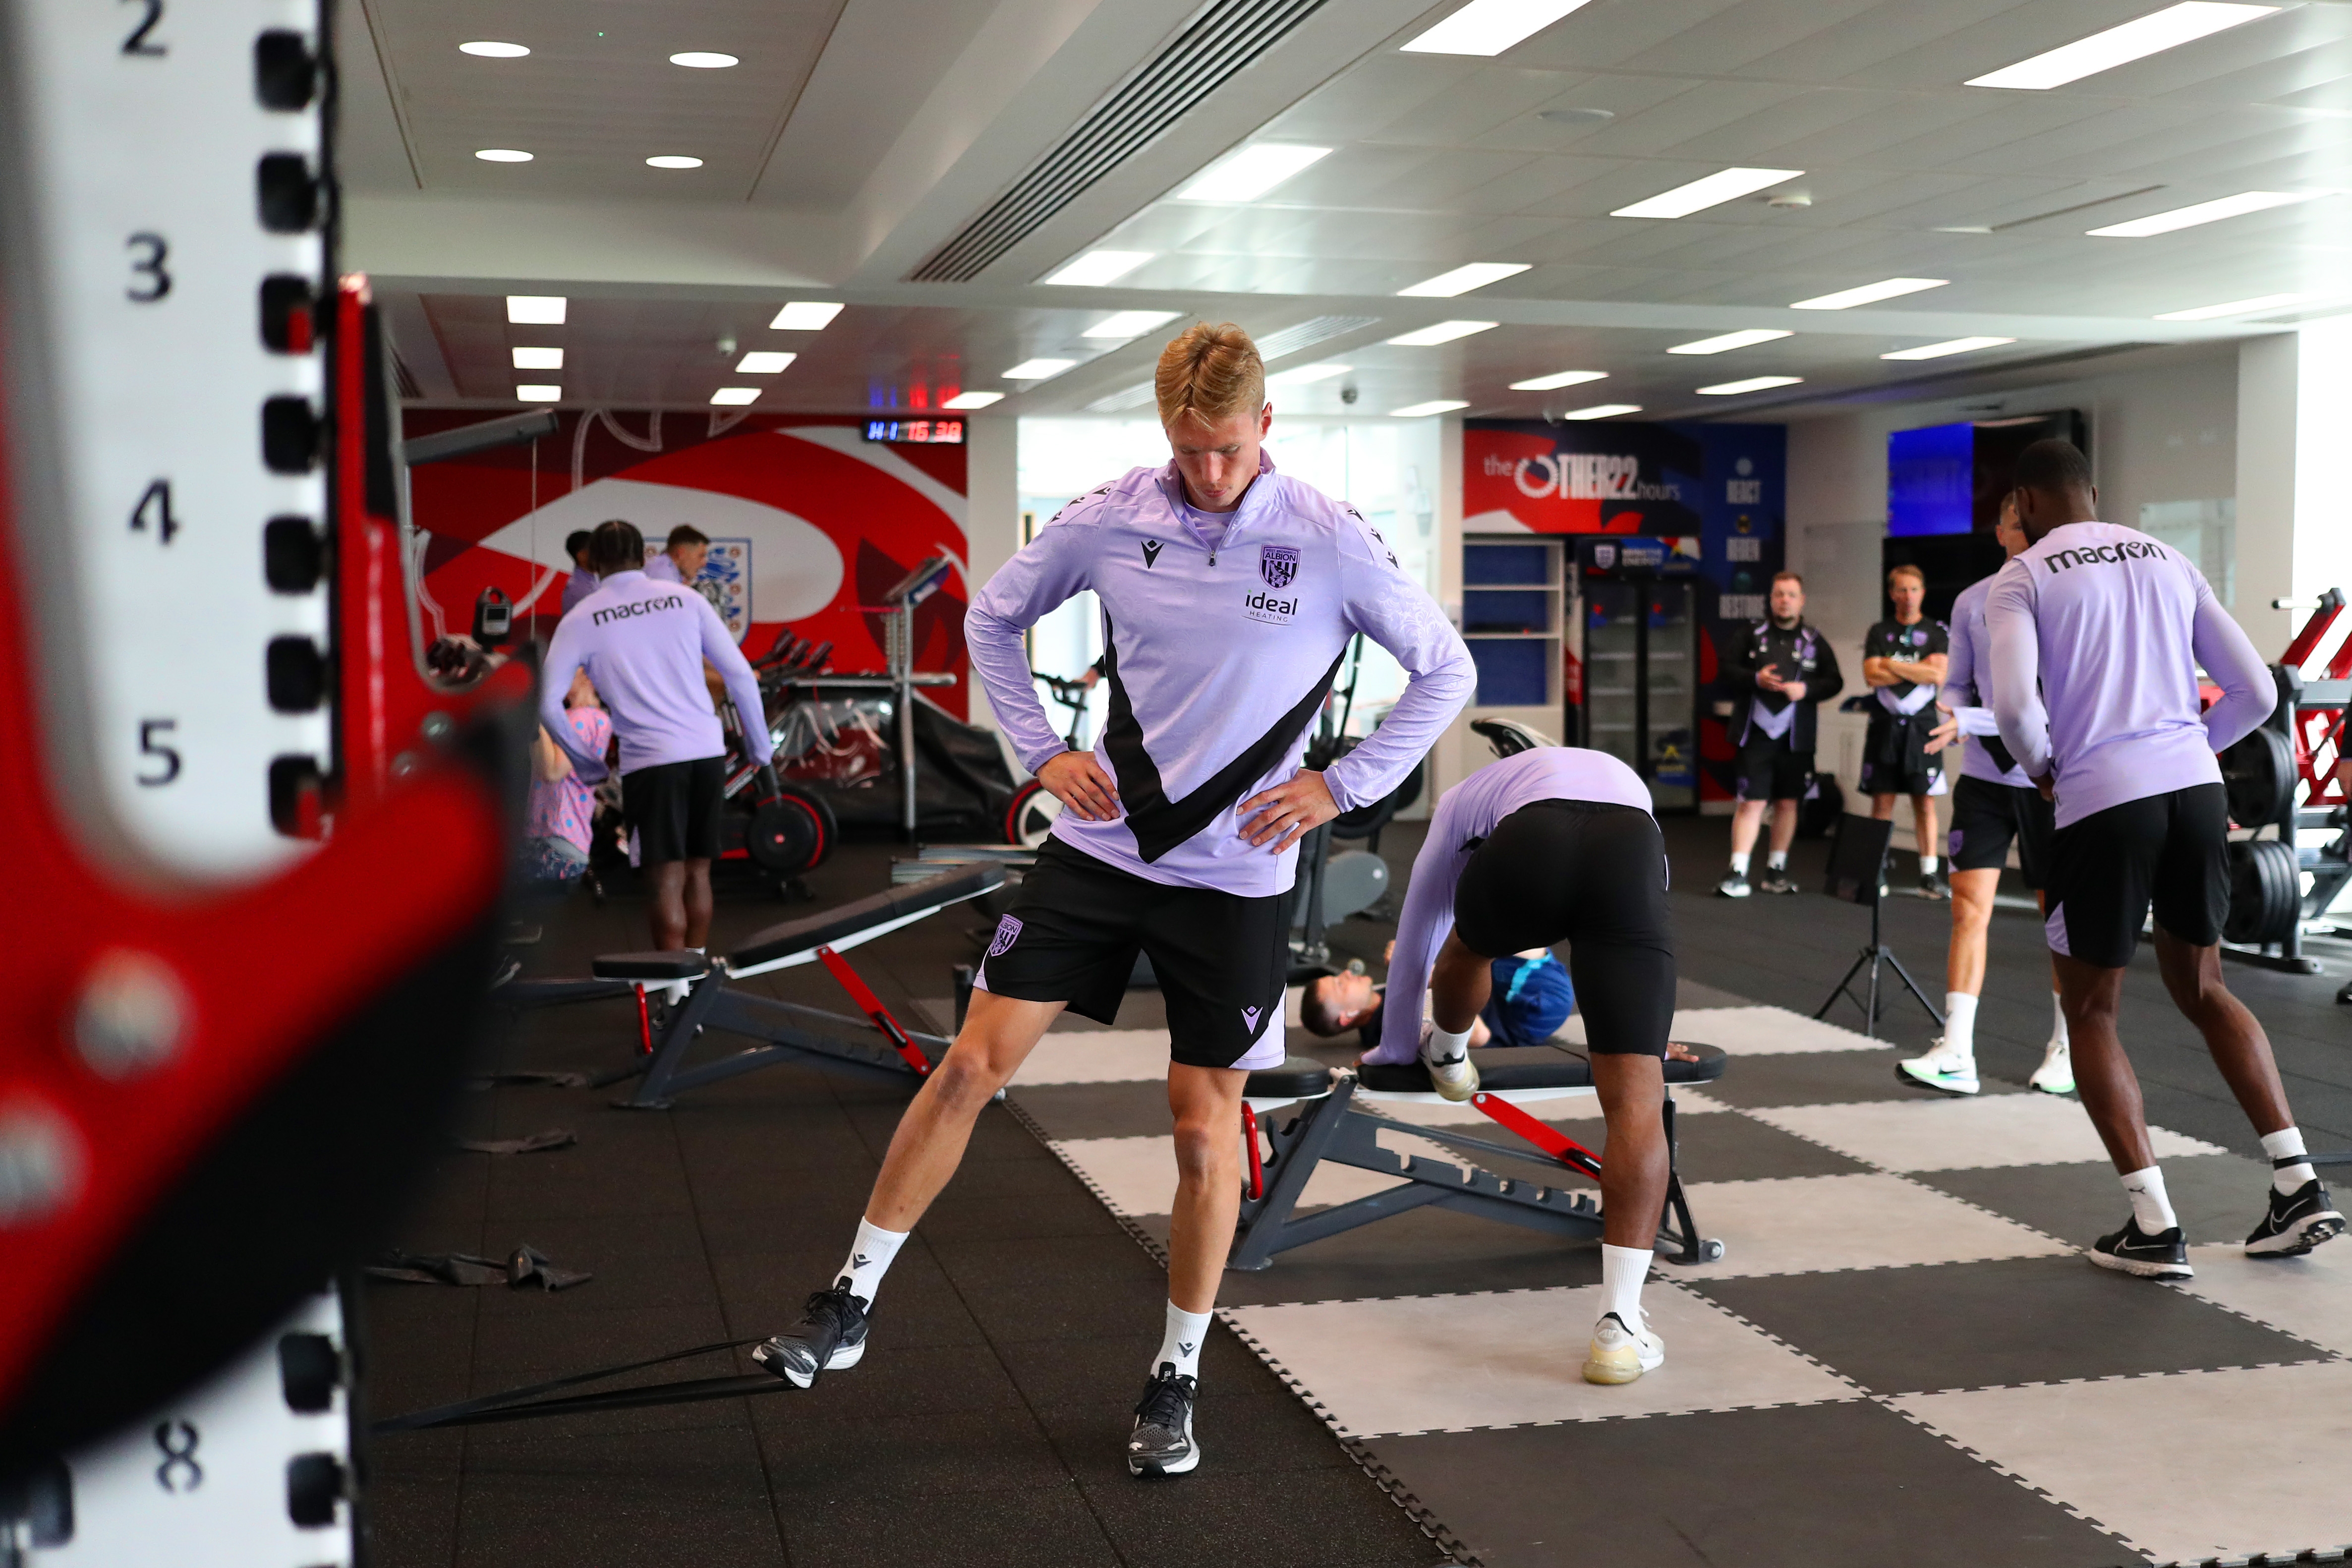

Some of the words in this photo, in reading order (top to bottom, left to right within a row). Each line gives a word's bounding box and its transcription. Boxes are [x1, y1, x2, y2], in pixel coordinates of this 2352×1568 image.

[122, 0, 168, 56] 2
[126, 232, 172, 303] 3
[1484, 454, 1513, 476] the
[1637, 483, 1681, 501] hours
[130, 477, 178, 544] 4
[1265, 552, 1296, 562] ALBION
[2044, 542, 2167, 574] macron
[592, 595, 683, 626] macron
[1246, 589, 1298, 615] ideal
[1250, 611, 1288, 622] HEATING
[136, 719, 181, 787] 5
[155, 1420, 202, 1494] 8
